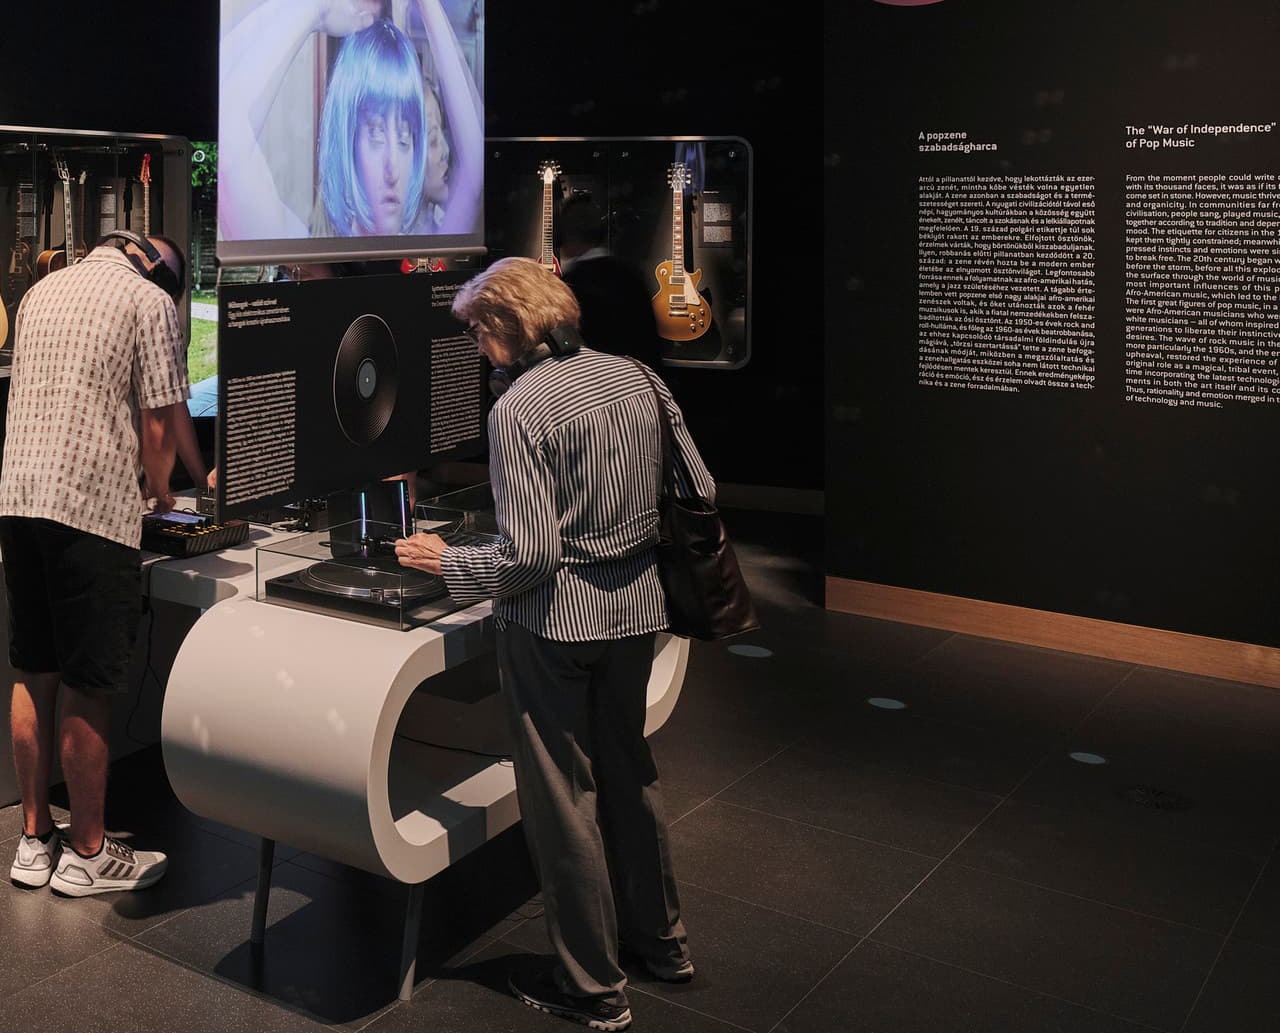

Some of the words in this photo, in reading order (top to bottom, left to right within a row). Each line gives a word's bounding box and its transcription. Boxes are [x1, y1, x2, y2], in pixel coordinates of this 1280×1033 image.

[1125, 126, 1145, 135] The
[1176, 124, 1189, 134] of
[918, 131, 925, 140] A
[926, 132, 967, 142] popzene
[918, 142, 998, 153] szabadságharca
[1125, 139, 1137, 148] of
[1140, 138, 1160, 150] Pop
[1163, 137, 1195, 148] Music
[1198, 174, 1226, 182] people
[1167, 228, 1202, 237] etiquette
[1204, 228, 1216, 236] for
[1193, 255, 1212, 263] 20th
[1247, 256, 1272, 265] began
[1126, 280, 1146, 288] most
[1149, 281, 1190, 290] important
[1193, 282, 1238, 291] influences
[1254, 284, 1271, 292] this
[1126, 289, 1181, 298] Afro-American
[1211, 292, 1236, 300] which
[1263, 293, 1277, 301] the
[1141, 298, 1156, 306] first
[1158, 299, 1177, 308] great
[1179, 300, 1206, 309] figures
[1217, 302, 1232, 310] pop
[1263, 302, 1271, 310] in
[1126, 315, 1147, 323] white
[1148, 316, 1189, 325] musicians
[1198, 318, 1208, 326] all
[1218, 319, 1244, 327] whom
[1245, 320, 1279, 330] inspired
[1126, 359, 1155, 369] original
[1157, 361, 1172, 369] role
[1228, 365, 1250, 373] tribal
[1126, 394, 1133, 402] of
[1135, 395, 1178, 406] technology
[1179, 398, 1195, 406] and
